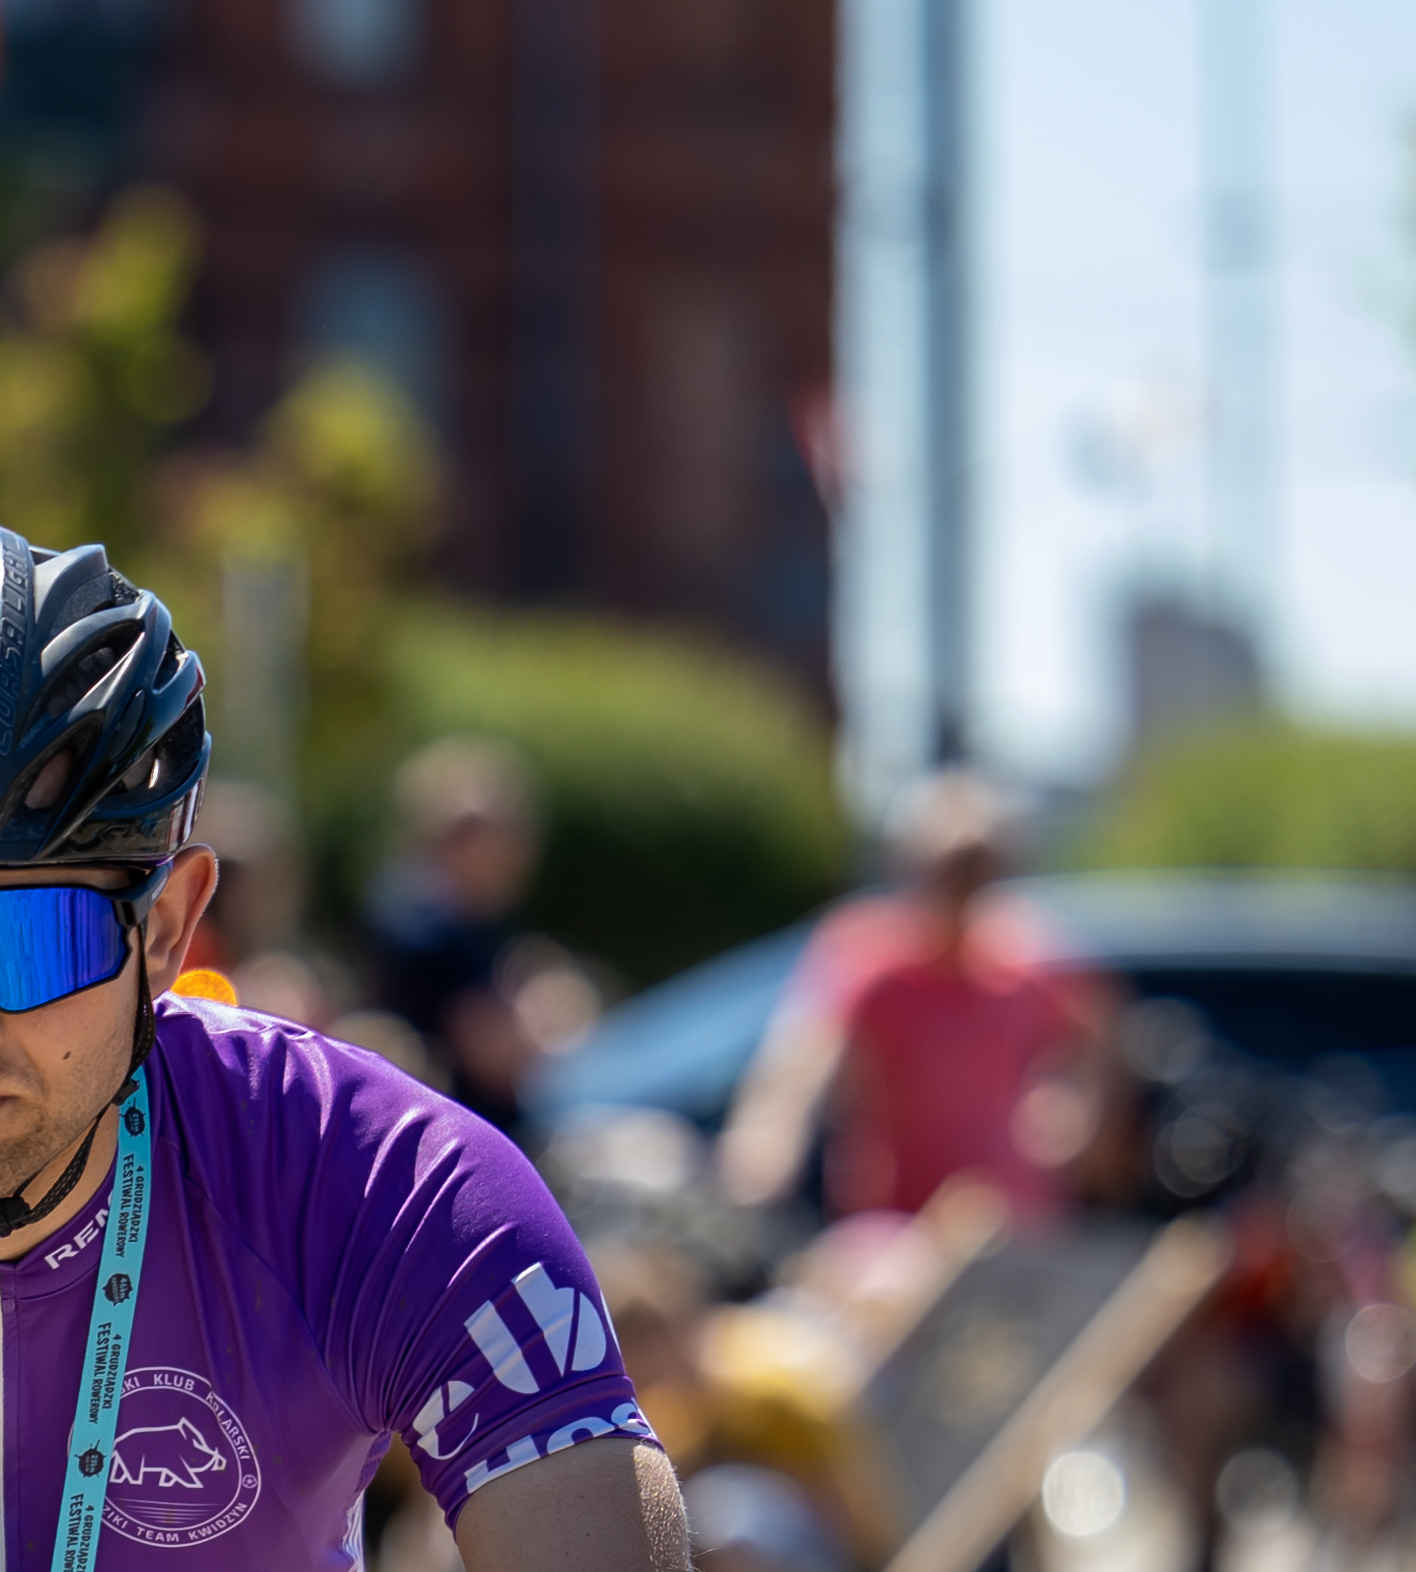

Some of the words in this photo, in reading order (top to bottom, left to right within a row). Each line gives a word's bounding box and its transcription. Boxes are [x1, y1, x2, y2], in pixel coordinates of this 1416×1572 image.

[121, 1153, 135, 1210] FESTIWAL
[115, 1211, 129, 1258] ROWEROWY
[94, 1322, 112, 1377] FESTIWAL
[112, 1333, 122, 1341] 4
[88, 1378, 103, 1425] ROWEROWY
[153, 1373, 195, 1392] KLUB
[206, 1392, 251, 1460] KOLARSKI
[66, 1493, 84, 1548] FESTIWAL
[101, 1505, 128, 1529] ZIKI
[137, 1526, 179, 1542] TEAM
[188, 1502, 248, 1540] KWIDZYN
